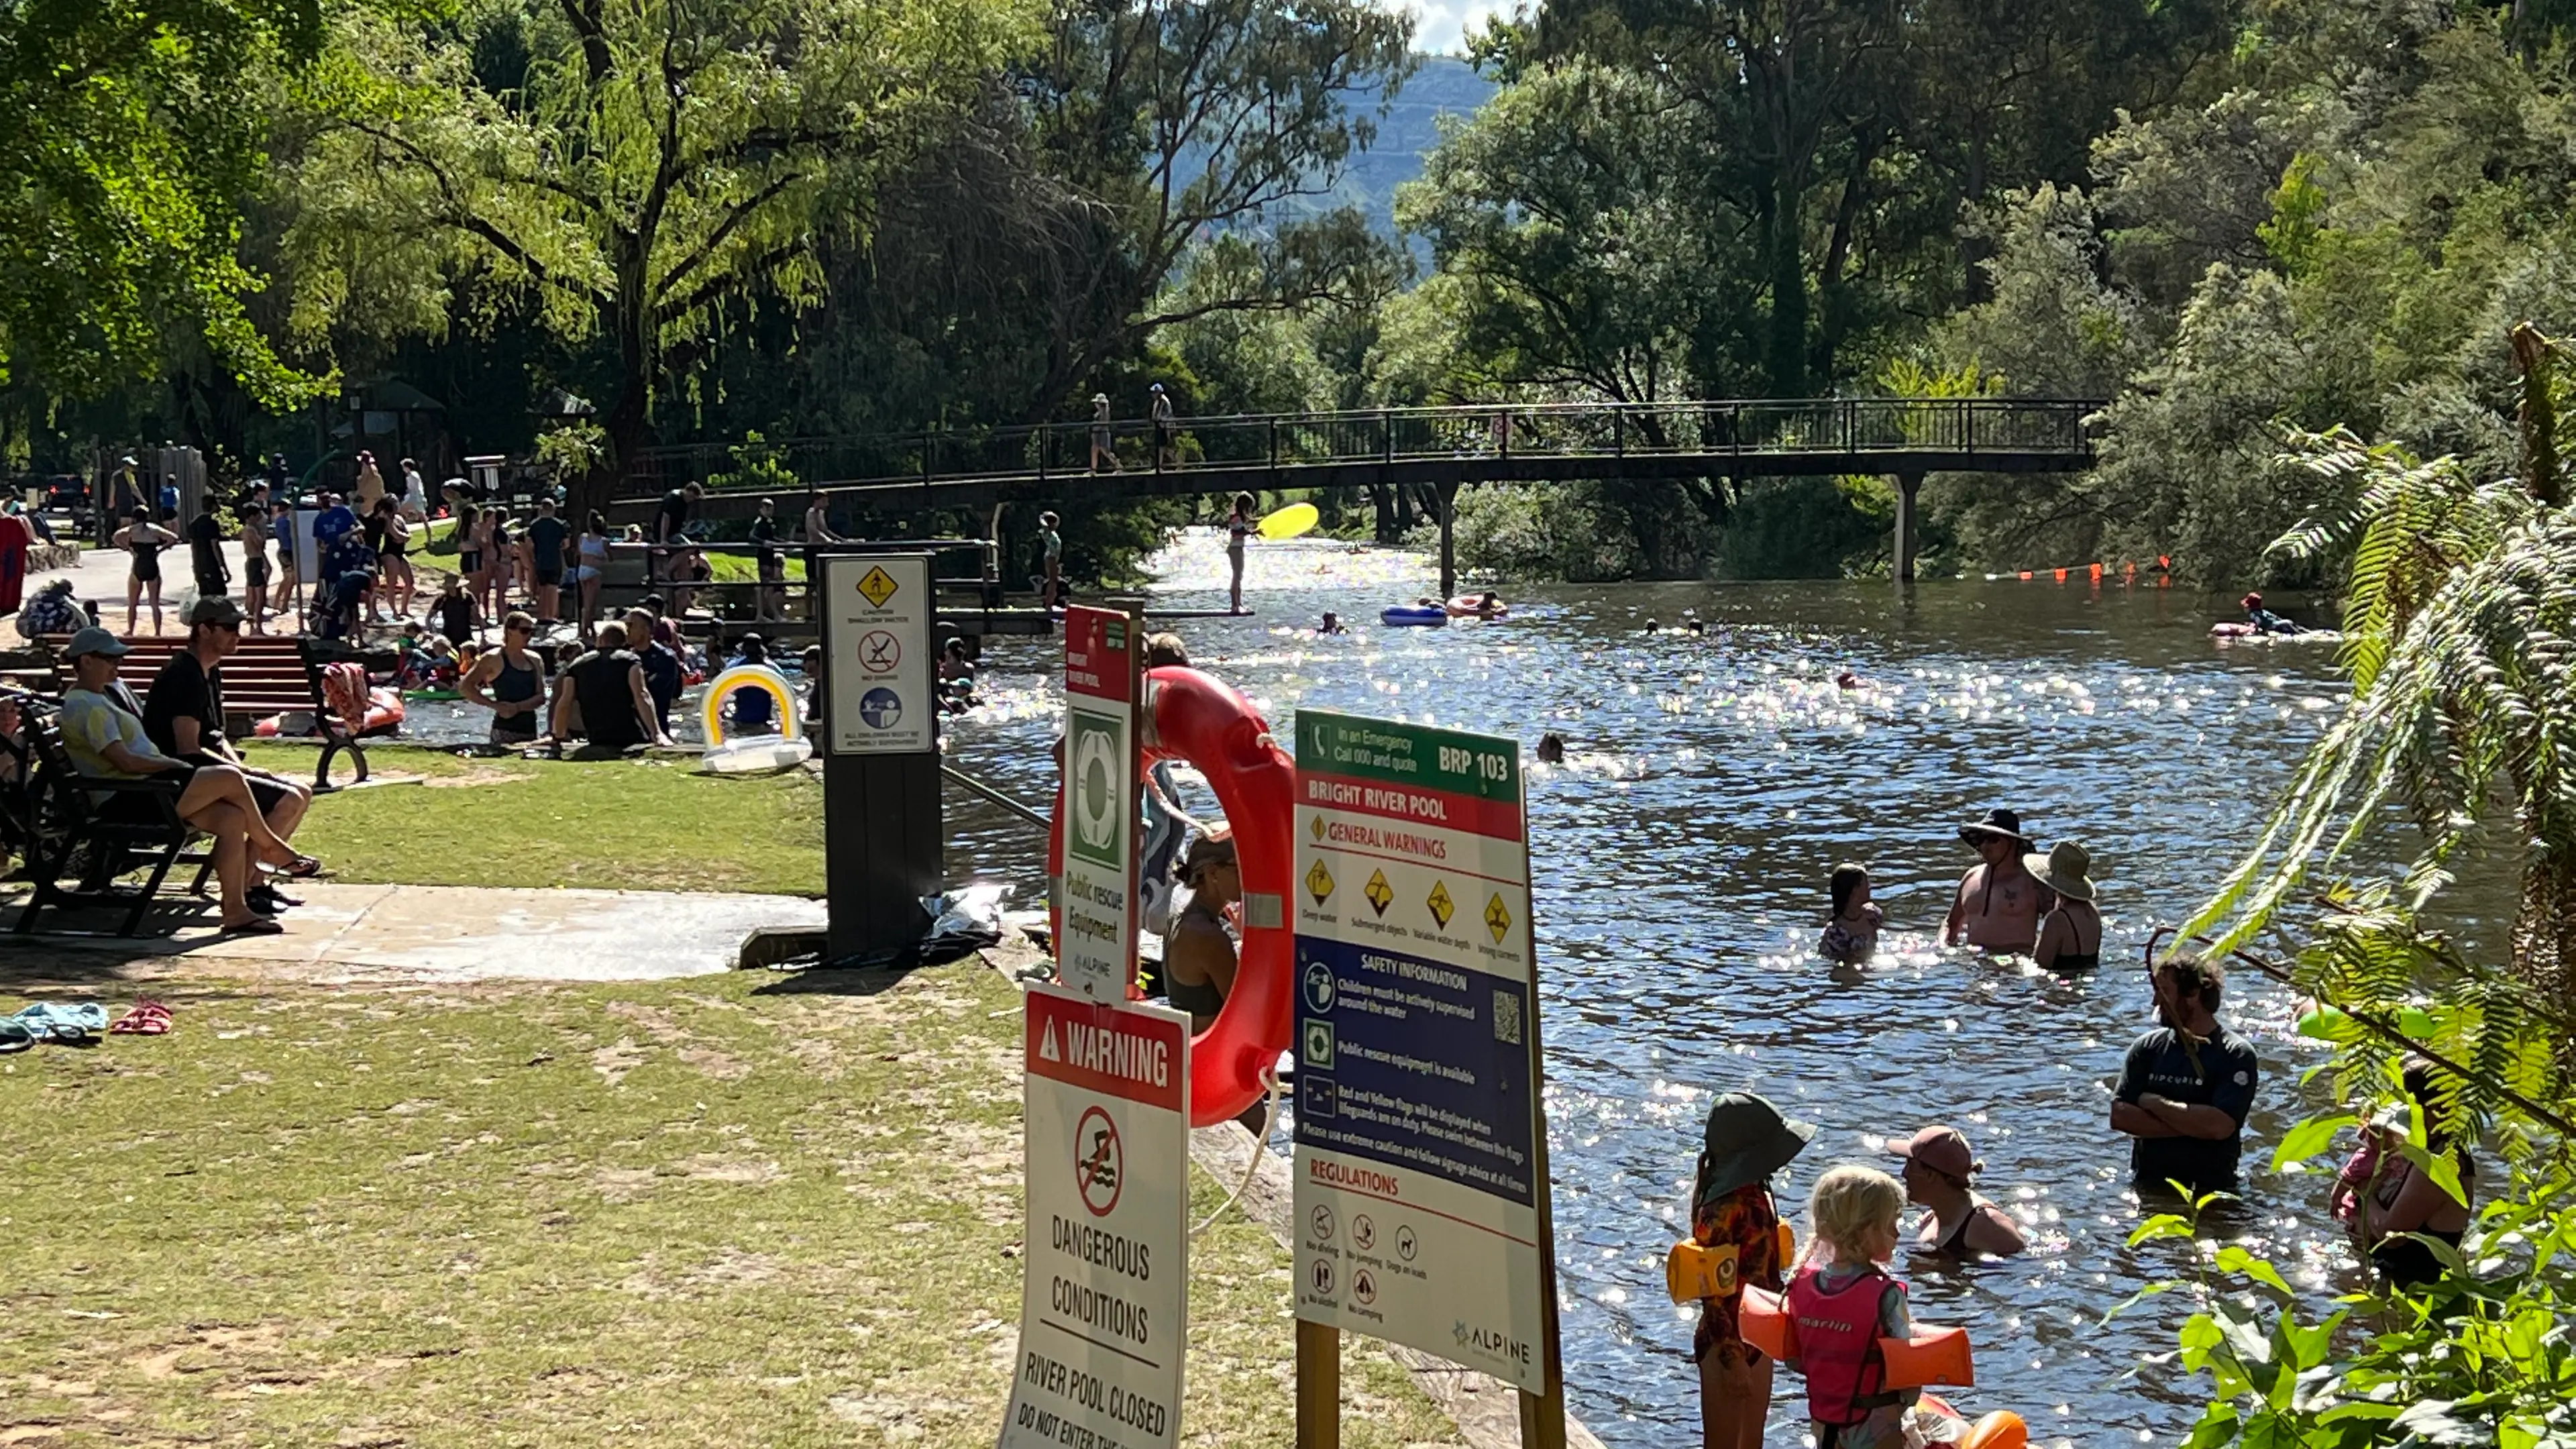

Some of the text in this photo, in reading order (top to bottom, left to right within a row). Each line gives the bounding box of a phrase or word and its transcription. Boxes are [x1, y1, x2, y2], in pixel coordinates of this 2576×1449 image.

[1334, 745, 1417, 772] Call 000 and quote
[1338, 727, 1413, 754] In an Emergency
[1439, 745, 1508, 782] BRP 103
[1309, 779, 1448, 820] BRIGHT RIVER POOL
[1328, 822, 1446, 859] GENERAL WARNINGS
[1066, 870, 1123, 912] Public rescue
[1069, 906, 1118, 945] Equipment
[1082, 956, 1111, 978] ALPINE
[1360, 953, 1467, 991] SAFETY INFORMATION
[1338, 978, 1475, 1020] Children must be actively supervised
[1338, 996, 1407, 1018] around the water
[1067, 1020, 1168, 1087] WARNING
[1338, 1040, 1475, 1085] Public rescue equipment is available
[1338, 1084, 1491, 1136] Red and Yellow flags will be displayed when
[1378, 1112, 1391, 1125] are
[1391, 1115, 1401, 1126] on
[1421, 1120, 1444, 1138] Please
[1464, 1132, 1494, 1153] between
[1493, 1142, 1506, 1157] the
[1302, 1121, 1327, 1138] Please
[1328, 1129, 1342, 1142] use
[1342, 1132, 1375, 1149] extreme
[1375, 1140, 1403, 1155] caution
[1403, 1146, 1417, 1159] and
[1418, 1147, 1441, 1165] follow
[1490, 1171, 1498, 1184] at
[1498, 1173, 1507, 1187] all
[1507, 1175, 1527, 1193] times
[1310, 1158, 1399, 1196] REGULATIONS
[1053, 1214, 1150, 1281] DANGEROUS
[1052, 1275, 1148, 1344] CONDITIONS
[1798, 1317, 1852, 1332] marlin
[1471, 1326, 1530, 1364] ALPINE
[1024, 1351, 1165, 1437] RIVER POOL CLOSED
[1018, 1402, 1036, 1430] DO
[1035, 1409, 1061, 1440] NOT
[1059, 1419, 1095, 1449] ENTER
